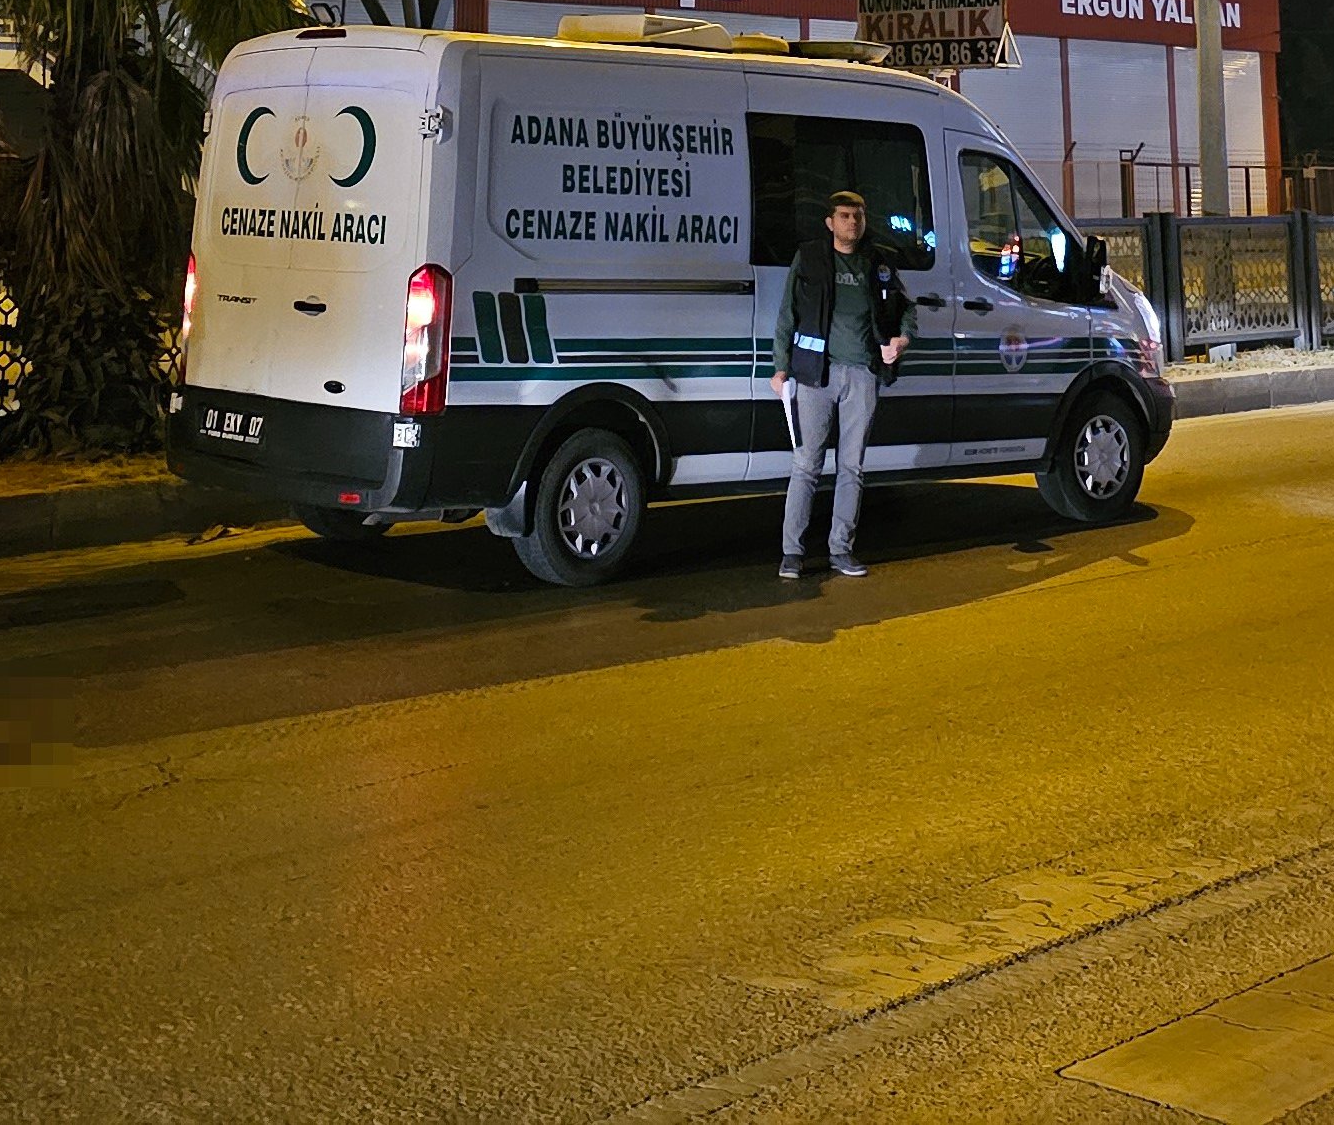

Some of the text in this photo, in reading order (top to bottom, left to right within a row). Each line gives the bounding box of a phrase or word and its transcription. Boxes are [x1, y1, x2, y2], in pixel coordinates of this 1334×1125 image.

[911, 42, 944, 66] 629
[949, 41, 971, 65] 86
[511, 112, 734, 162] ADANA BÜYÜKŞEHİR
[562, 162, 692, 198] BELEDİYESİ
[221, 202, 387, 245] CENAZE NAKİL ARACI
[505, 207, 740, 246] CENAZE NAKİL ARACI
[218, 294, 258, 304] TRANSIT
[205, 409, 218, 429] 01
[249, 417, 264, 437] 07
